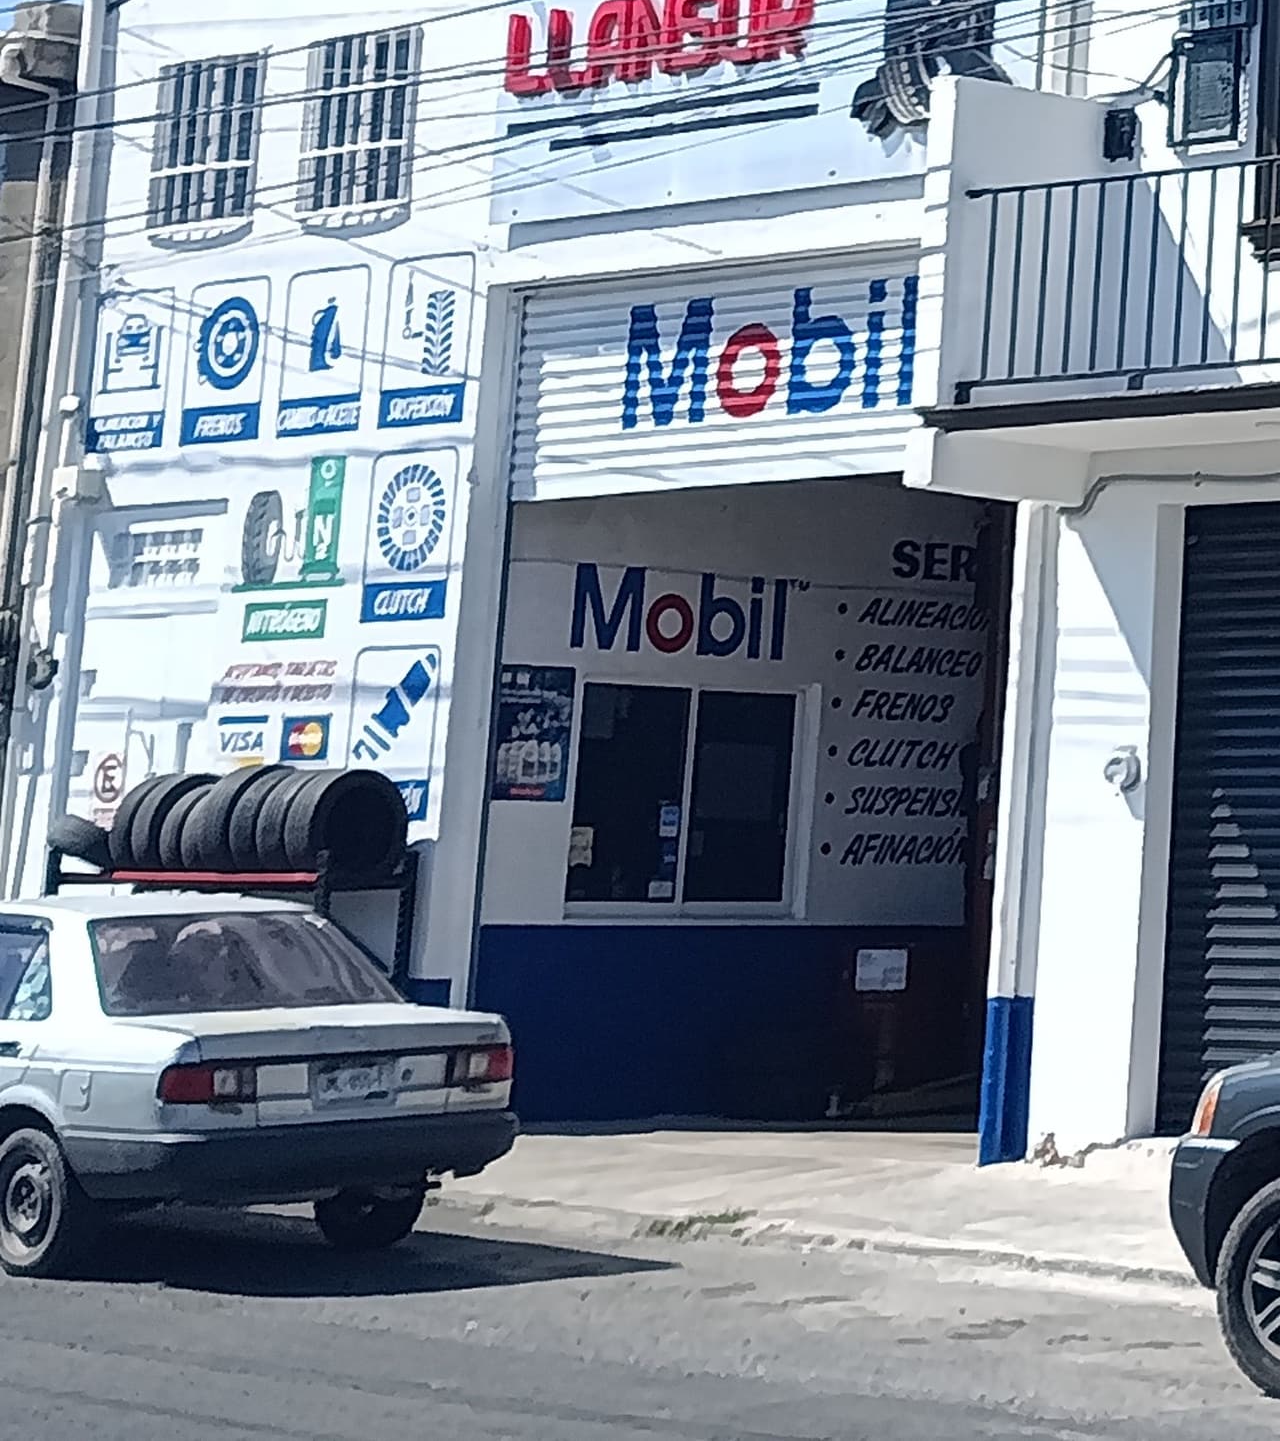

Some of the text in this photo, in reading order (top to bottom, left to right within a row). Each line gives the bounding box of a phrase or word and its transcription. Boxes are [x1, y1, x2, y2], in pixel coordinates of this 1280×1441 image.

[621, 274, 920, 430] Mobil
[373, 587, 433, 617] CLUTCH
[570, 562, 789, 661] Mobil
[855, 644, 982, 678] BALANCEO
[852, 689, 955, 724] FRENOS
[219, 731, 265, 752] VISA
[847, 738, 960, 772] CLUTCH
